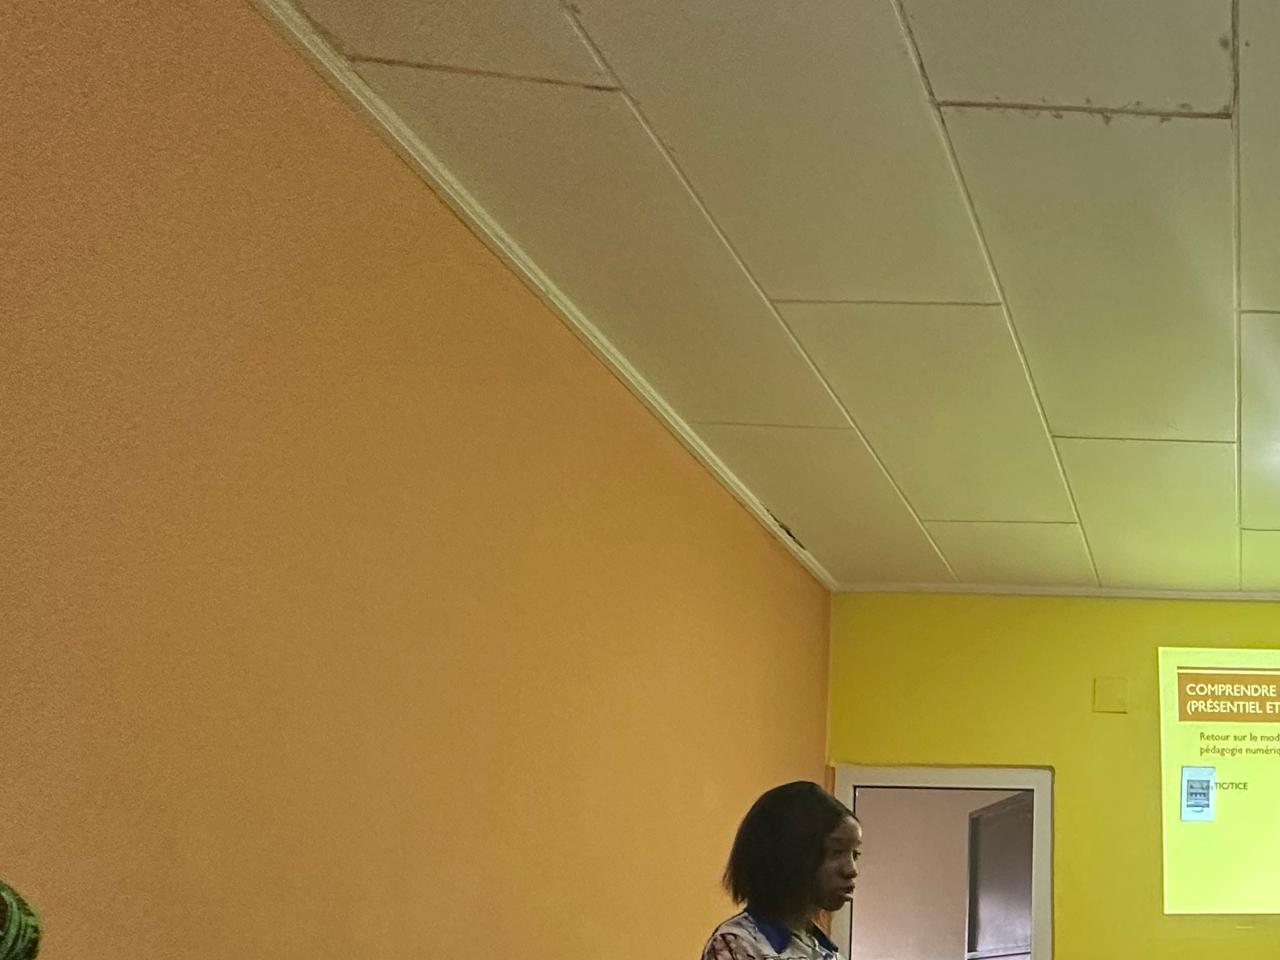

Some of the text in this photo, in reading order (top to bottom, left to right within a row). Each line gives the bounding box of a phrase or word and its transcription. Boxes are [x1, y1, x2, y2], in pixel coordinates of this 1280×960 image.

[1186, 683, 1276, 697] COMPRENDRE
[1186, 699, 1262, 715] (PRÉSENTIEL
[1266, 702, 1280, 713] ET
[1199, 732, 1229, 742] Retour
[1233, 734, 1246, 742] sur
[1249, 732, 1258, 742] le
[1199, 746, 1243, 757] pédagogie
